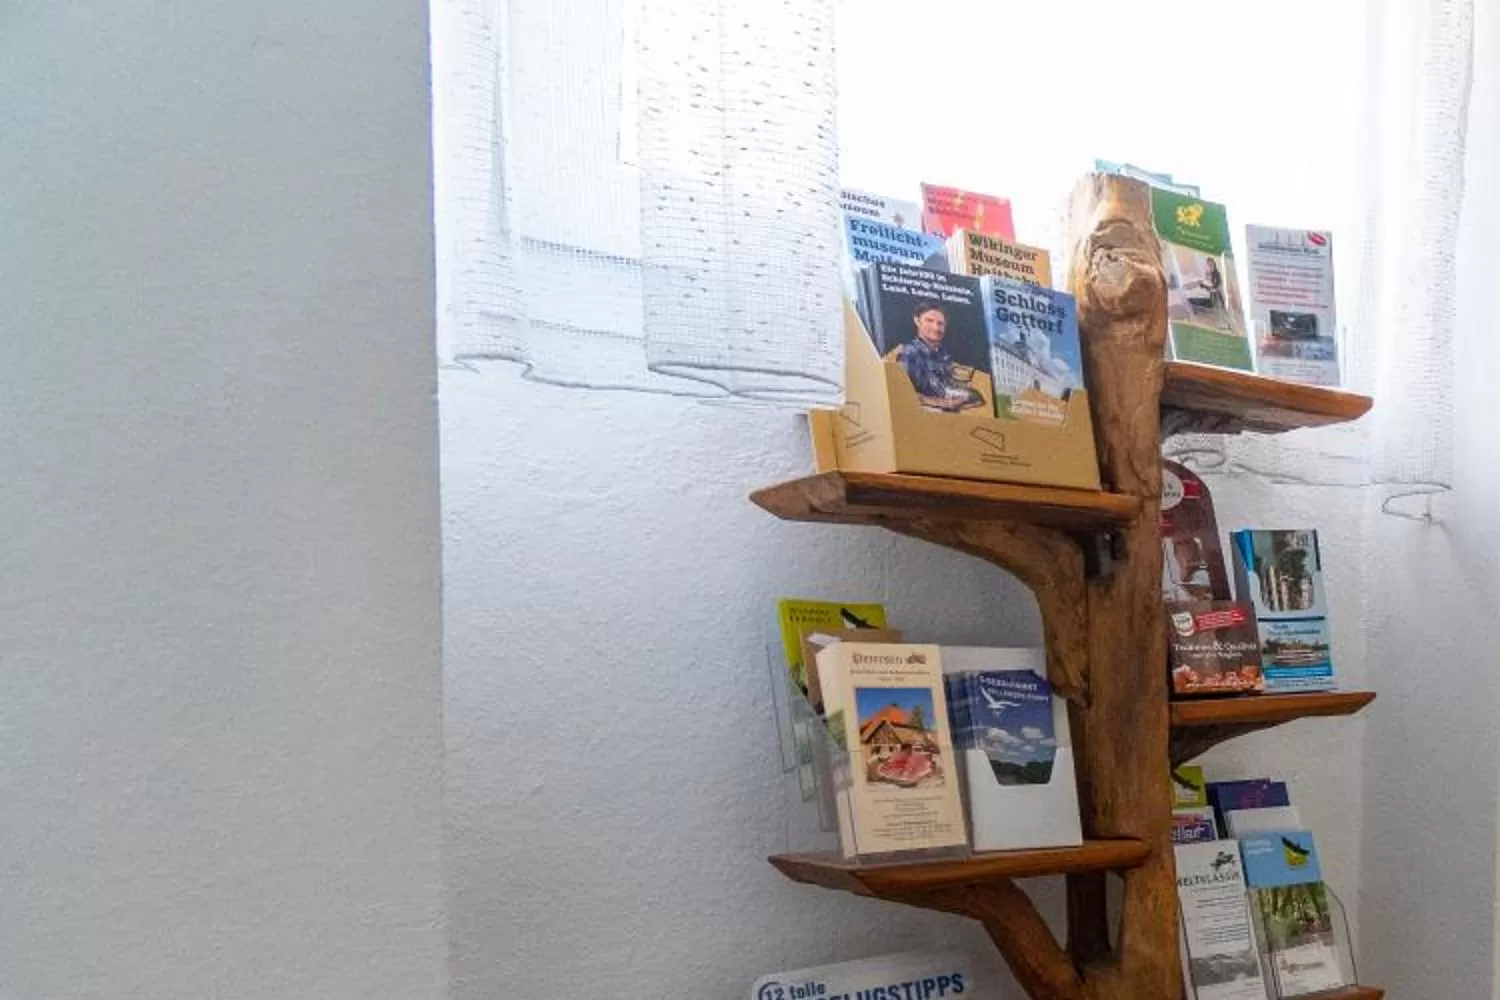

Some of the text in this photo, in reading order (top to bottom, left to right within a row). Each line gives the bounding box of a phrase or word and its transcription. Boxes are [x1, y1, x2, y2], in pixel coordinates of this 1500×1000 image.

[850, 218, 929, 248] Freilicht-
[967, 230, 1039, 261] Wikinger
[852, 236, 926, 261] museum
[969, 247, 1036, 275] Museum
[993, 287, 1068, 318] Schloss
[995, 306, 1064, 336] Gottorf
[789, 981, 826, 1000] tolle
